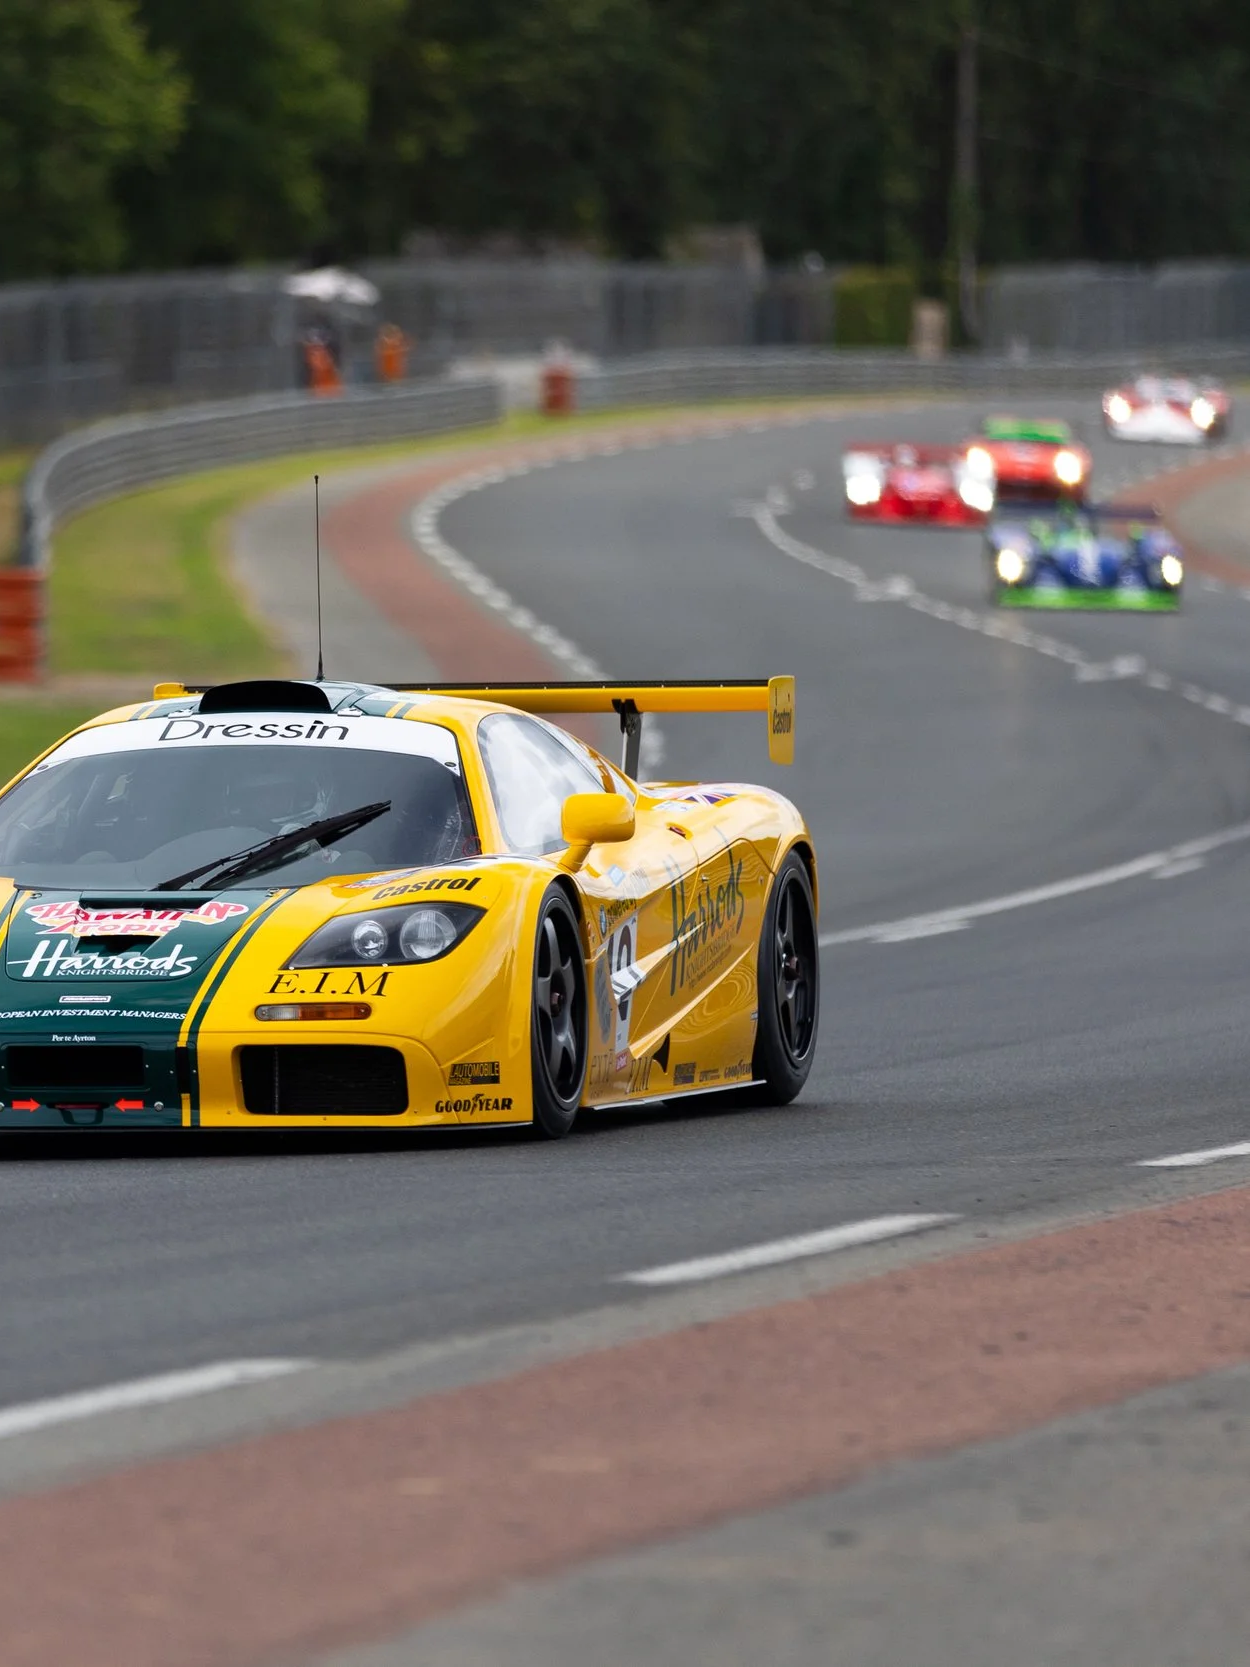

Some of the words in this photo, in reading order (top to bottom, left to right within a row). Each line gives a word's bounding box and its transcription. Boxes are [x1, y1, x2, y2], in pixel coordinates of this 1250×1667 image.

[158, 719, 349, 741] Dressin
[372, 877, 482, 900] Castrol
[662, 826, 744, 997] Harrods
[7, 939, 198, 977] Harrods
[264, 971, 393, 996] E.I.M
[41, 1009, 120, 1017] INVESTMENT
[119, 1010, 187, 1020] MANAGERS
[72, 1034, 96, 1042] Ayrton
[435, 1093, 513, 1115] GOODYEAR
